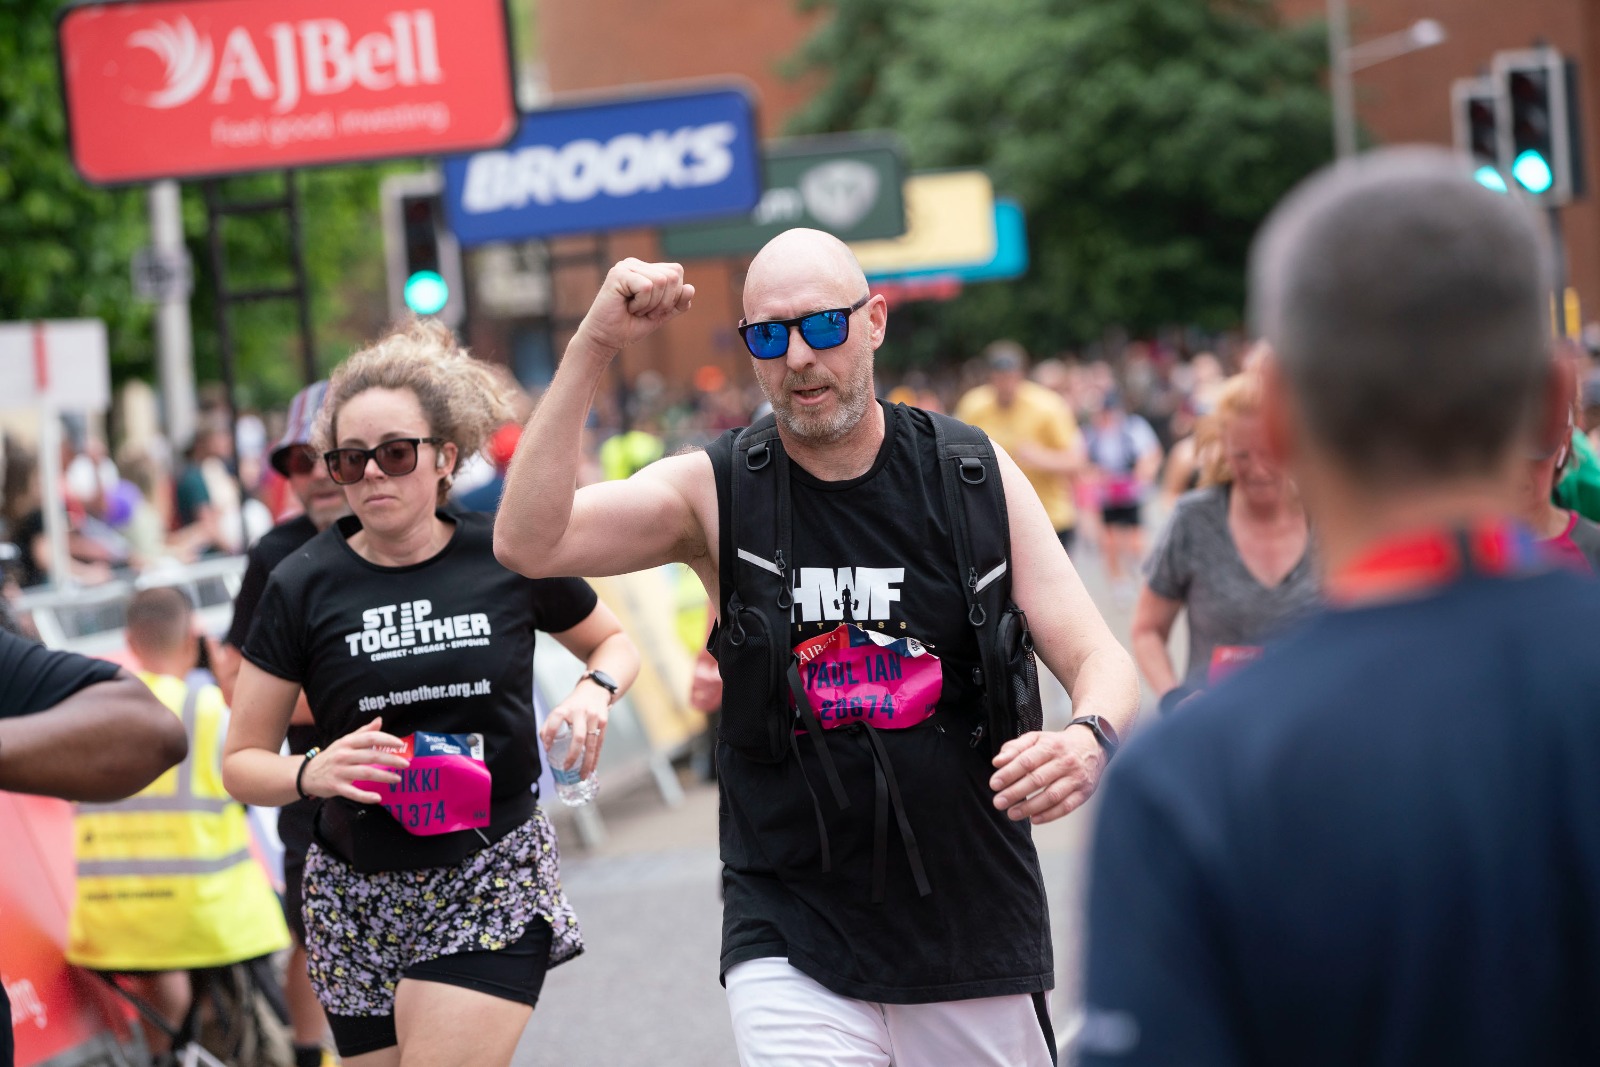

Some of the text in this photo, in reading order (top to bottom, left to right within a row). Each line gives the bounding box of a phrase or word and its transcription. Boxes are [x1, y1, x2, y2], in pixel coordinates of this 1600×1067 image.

[462, 121, 738, 214] BROOKS
[791, 566, 905, 623] HWF
[362, 599, 433, 631] STEP
[345, 612, 492, 657] TOGETHER
[370, 637, 491, 662] CONNECT ENGAGE EMPOWER
[806, 653, 903, 690] PAUL IAN
[359, 678, 491, 712] step-together.org.uk
[820, 693, 895, 721] 20674
[387, 768, 439, 793] VIKKI
